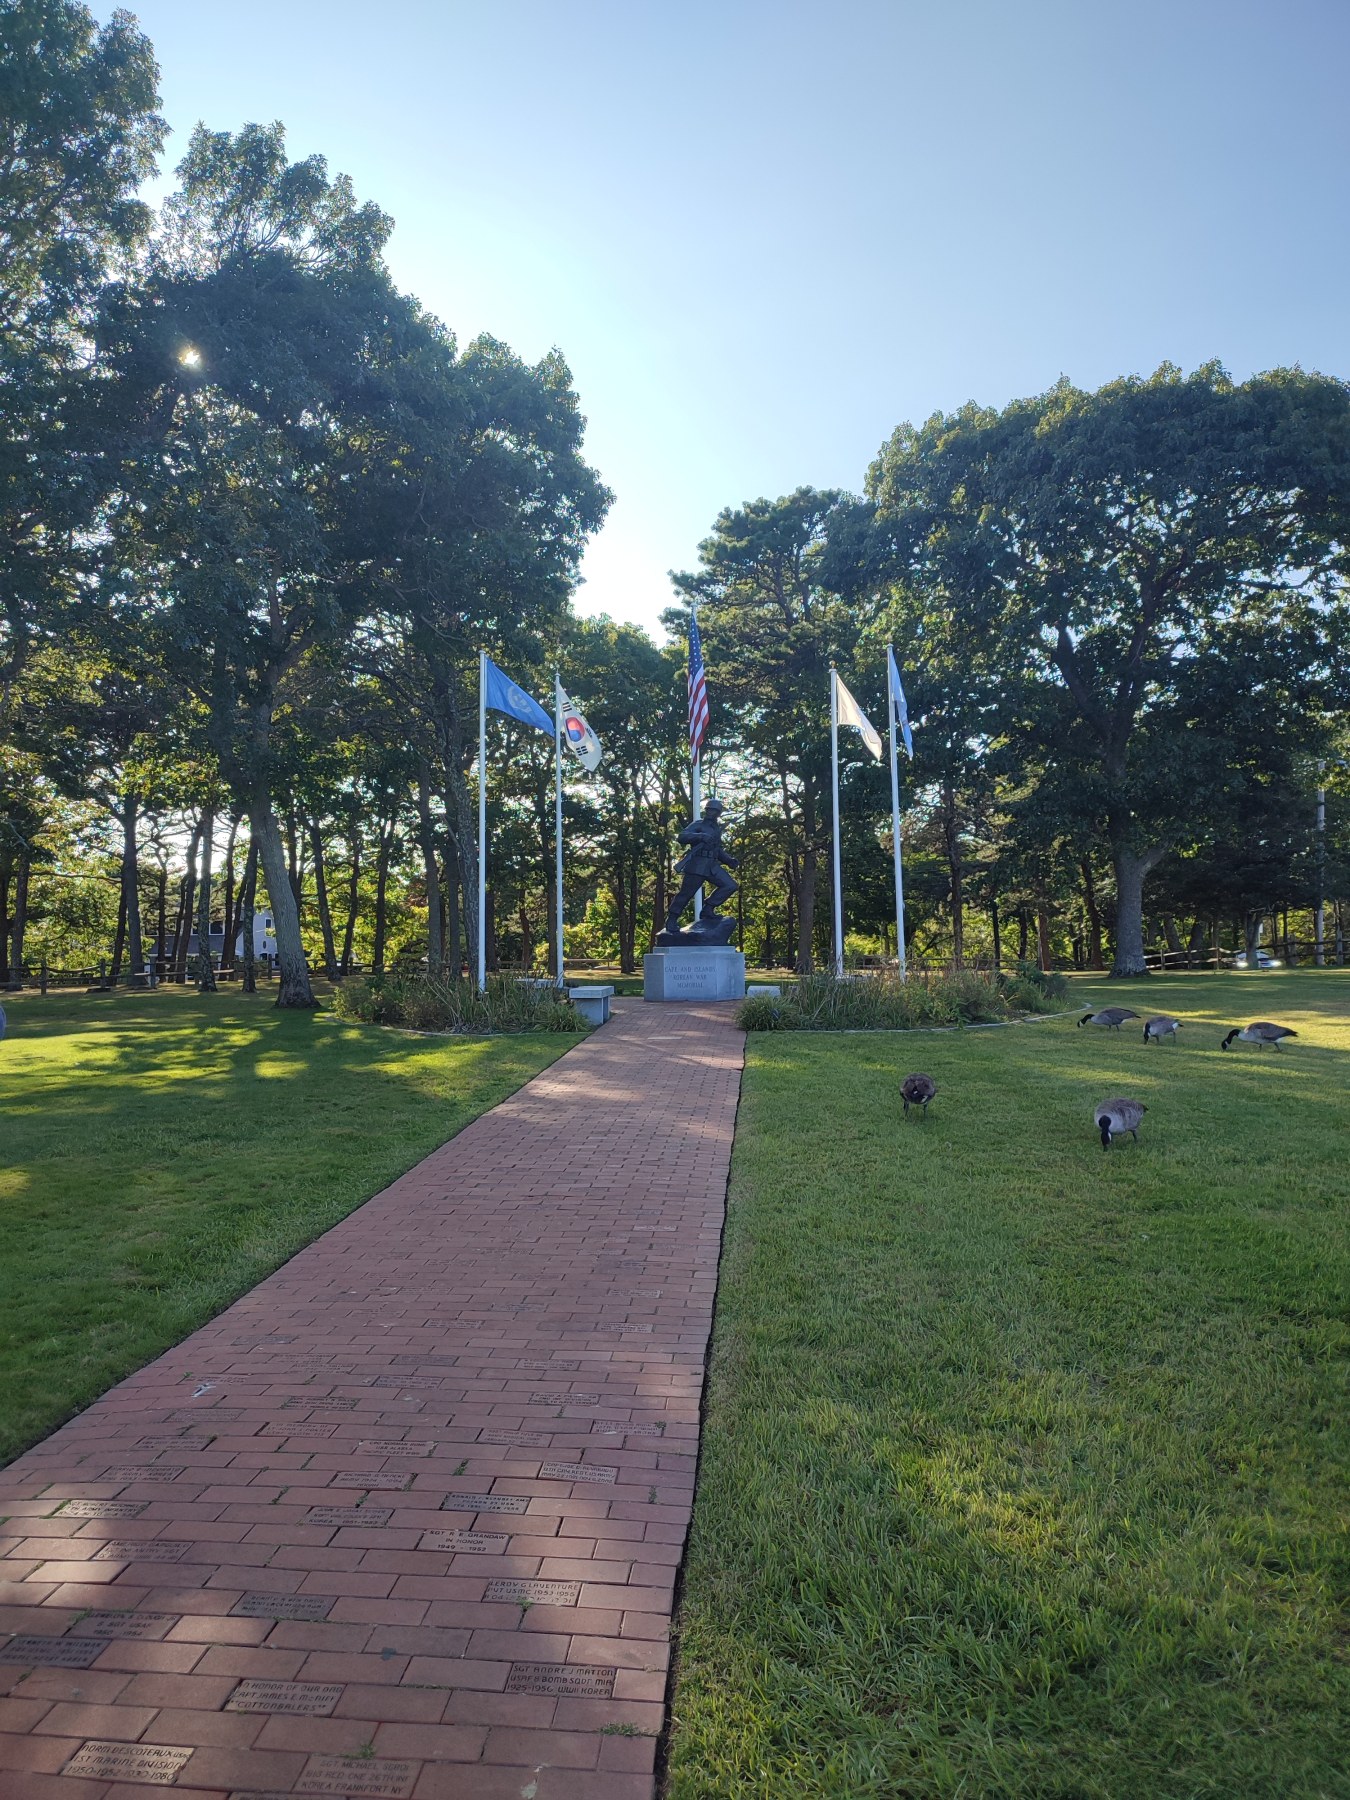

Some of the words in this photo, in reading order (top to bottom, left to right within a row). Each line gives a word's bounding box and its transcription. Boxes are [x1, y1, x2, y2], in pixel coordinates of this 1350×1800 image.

[575, 1668, 613, 1676] MATTON
[255, 1692, 290, 1700] JAMES
[580, 1687, 610, 1696] KOREA
[79, 1744, 112, 1753] NORM
[109, 1746, 175, 1757] DESCOTEAUX
[72, 1754, 91, 1762] 1ST
[91, 1756, 137, 1765] MARINE
[136, 1759, 183, 1769] DIVISION
[318, 1759, 339, 1767] SGT
[340, 1760, 378, 1769] MICHAEL
[323, 1770, 345, 1778] RED
[346, 1771, 367, 1780] ONE
[300, 1780, 333, 1790] KOREA
[333, 1782, 388, 1793] FRANKFORT
[389, 1785, 403, 1794] NY
